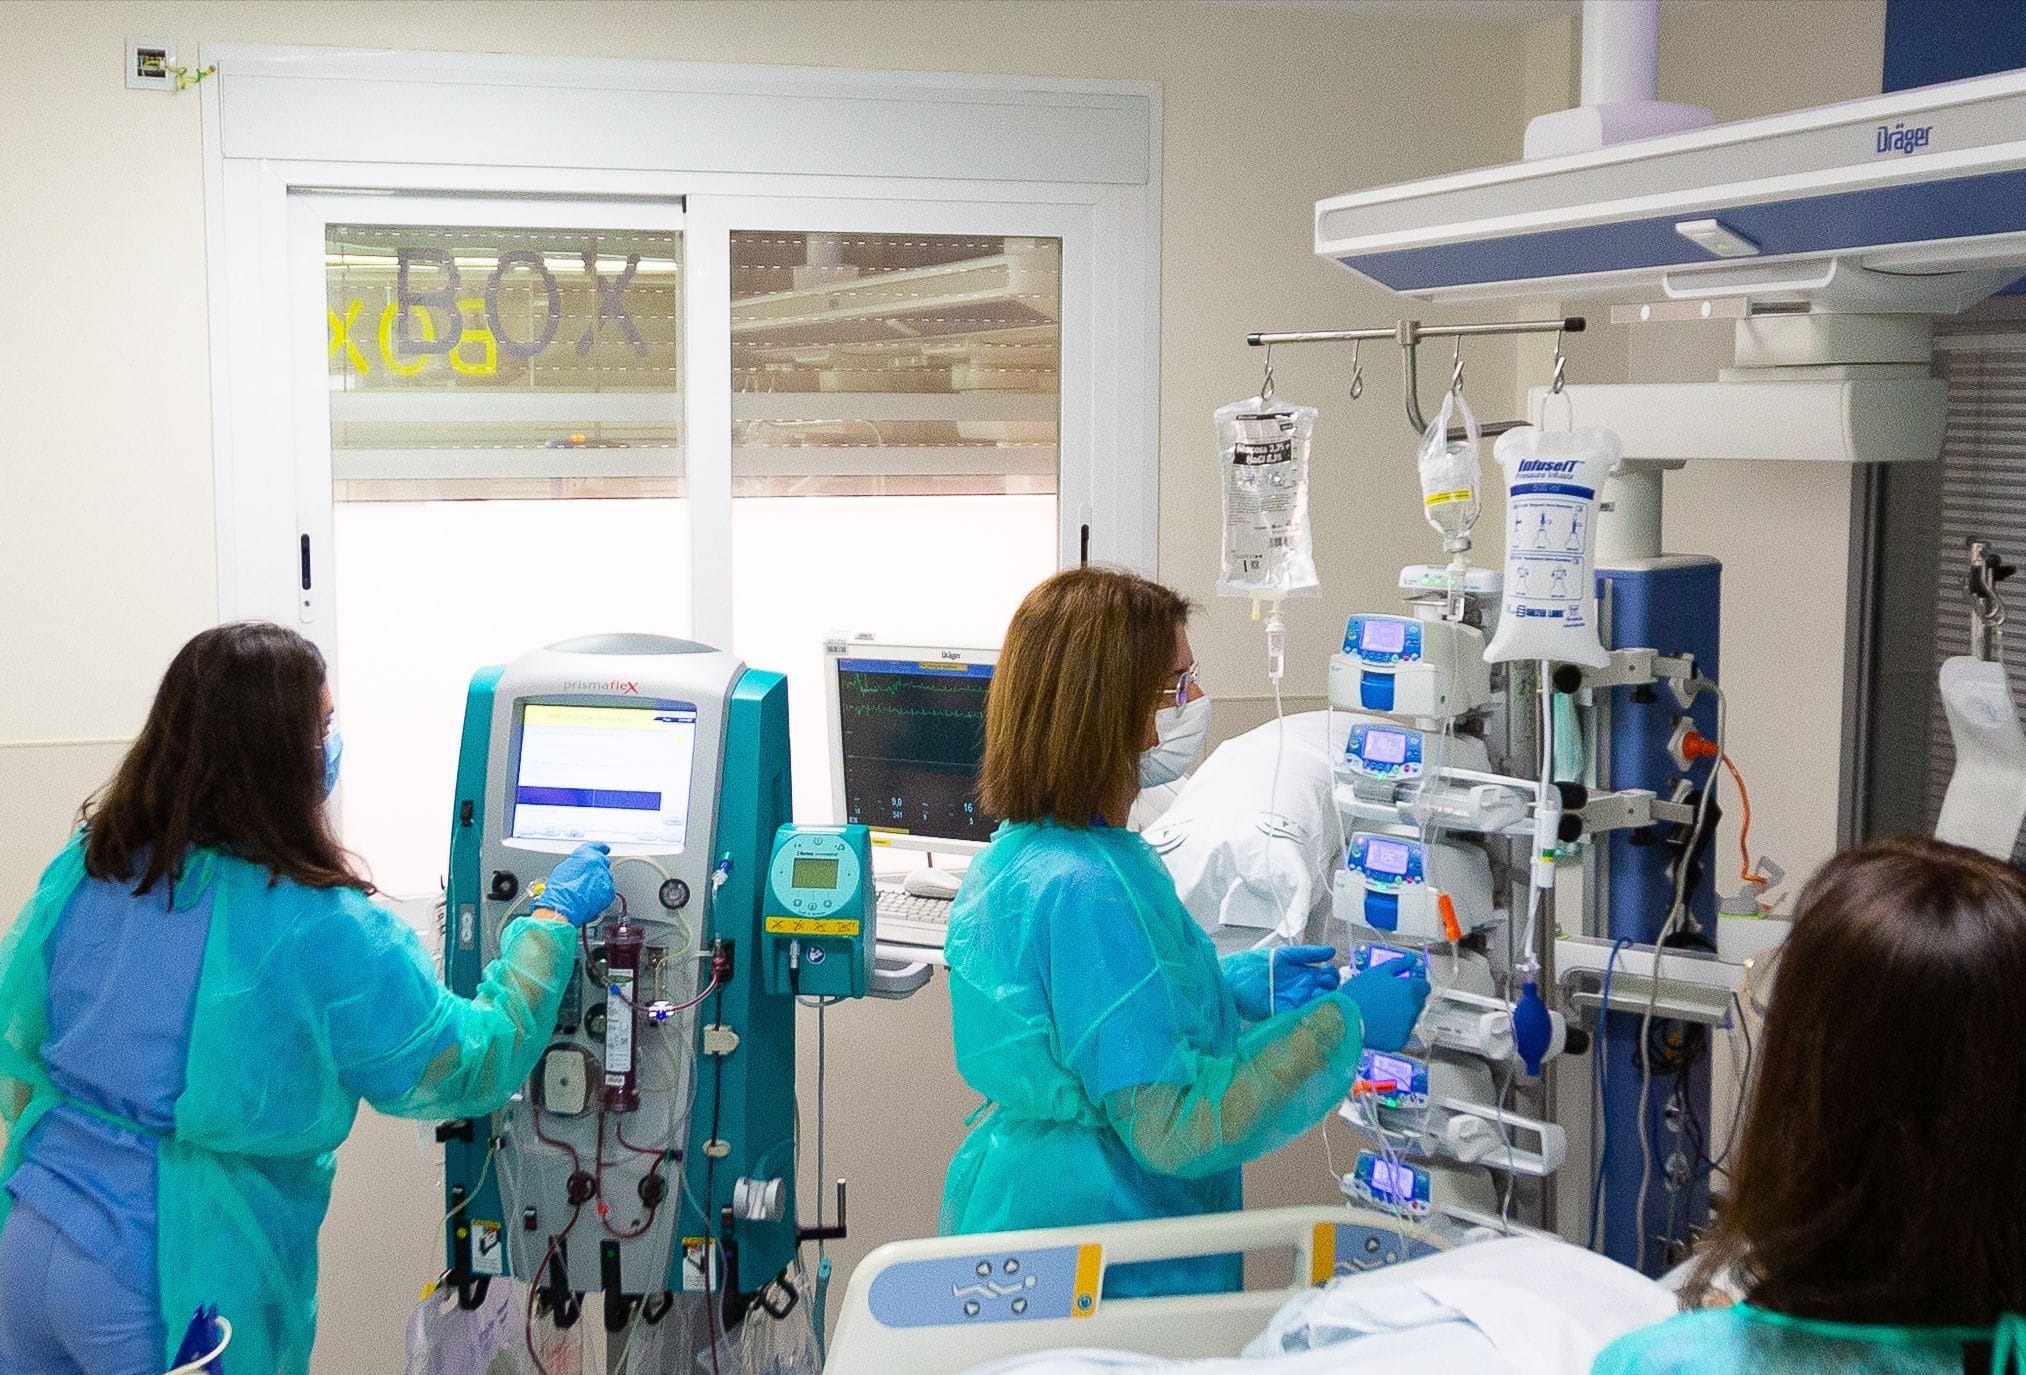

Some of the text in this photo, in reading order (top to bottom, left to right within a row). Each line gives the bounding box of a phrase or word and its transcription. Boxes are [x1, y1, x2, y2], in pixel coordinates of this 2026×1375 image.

[1877, 123, 1933, 154] Dräger
[397, 249, 646, 357] BOX
[563, 680, 639, 695] prismaflex
